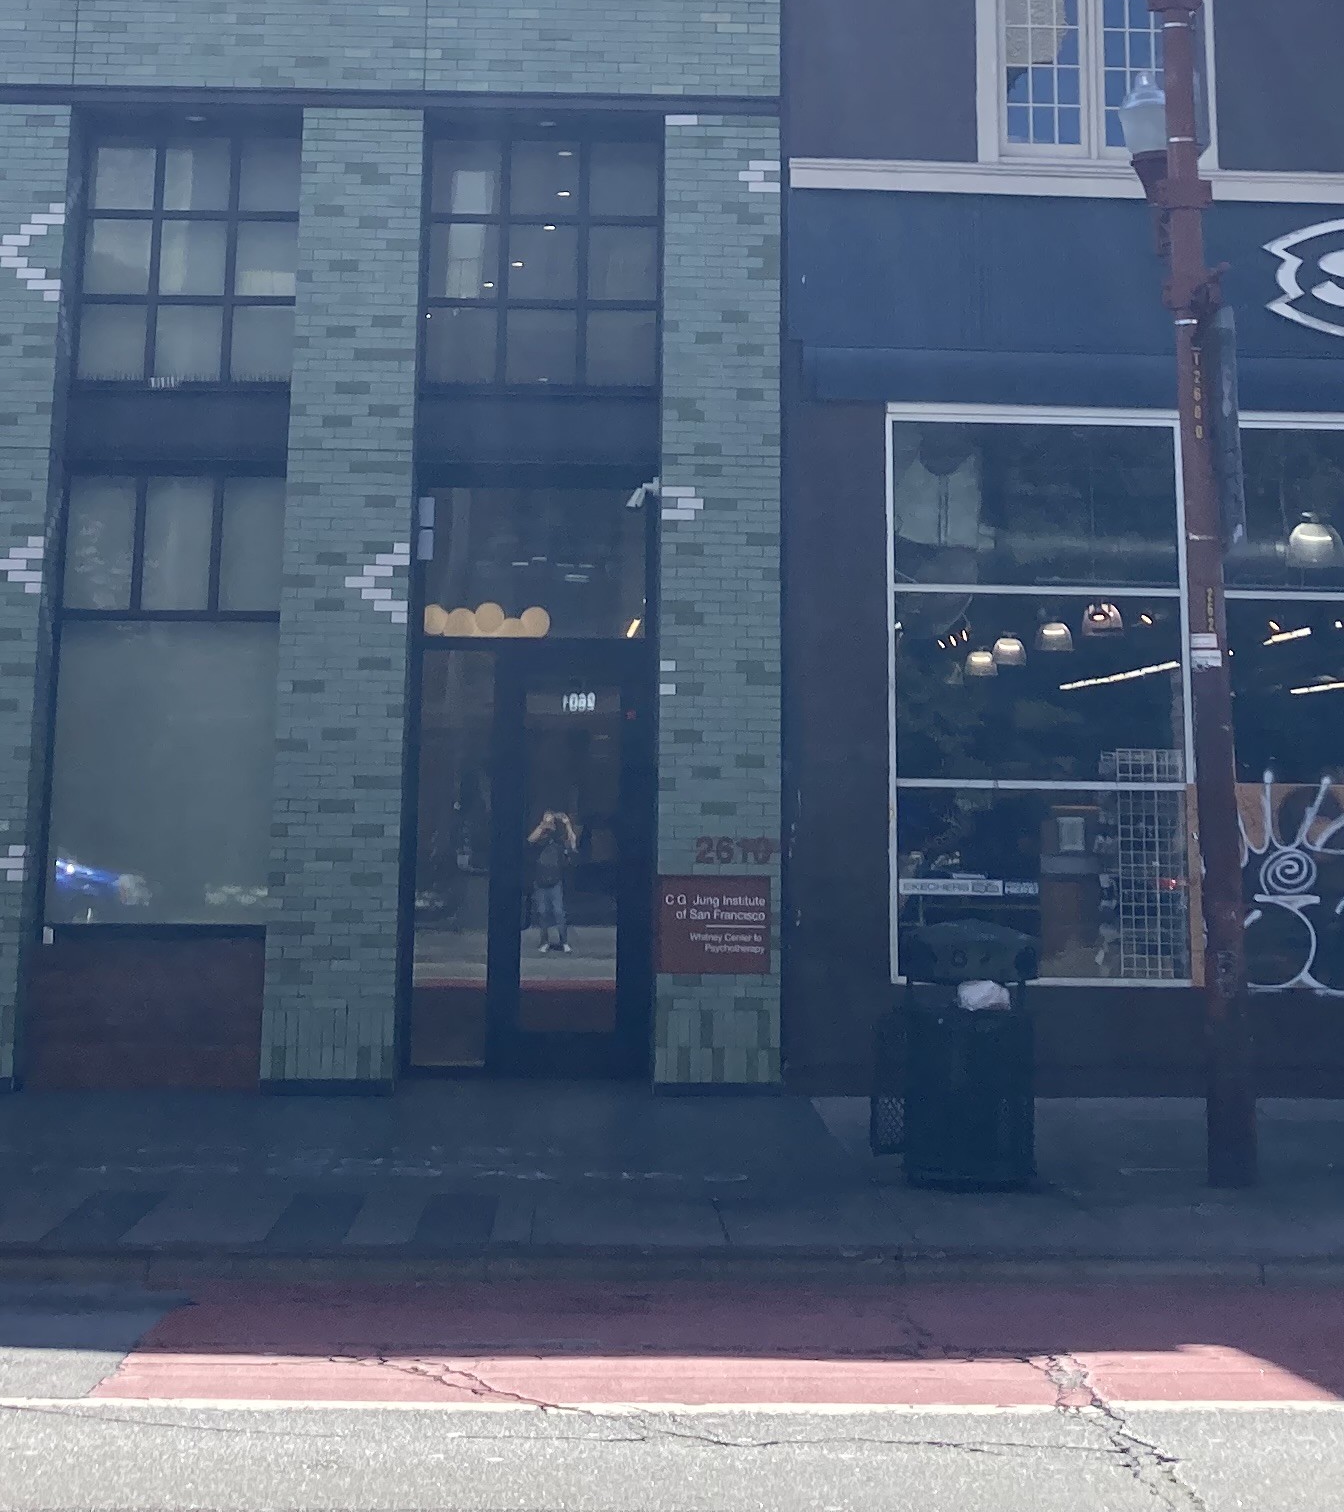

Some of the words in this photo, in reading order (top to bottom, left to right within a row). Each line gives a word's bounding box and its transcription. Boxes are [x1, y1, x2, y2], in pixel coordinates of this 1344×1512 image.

[693, 895, 720, 908] Jung
[722, 895, 766, 908] Institute
[675, 908, 687, 921] of
[689, 908, 711, 921] San
[713, 909, 766, 922] Francisco
